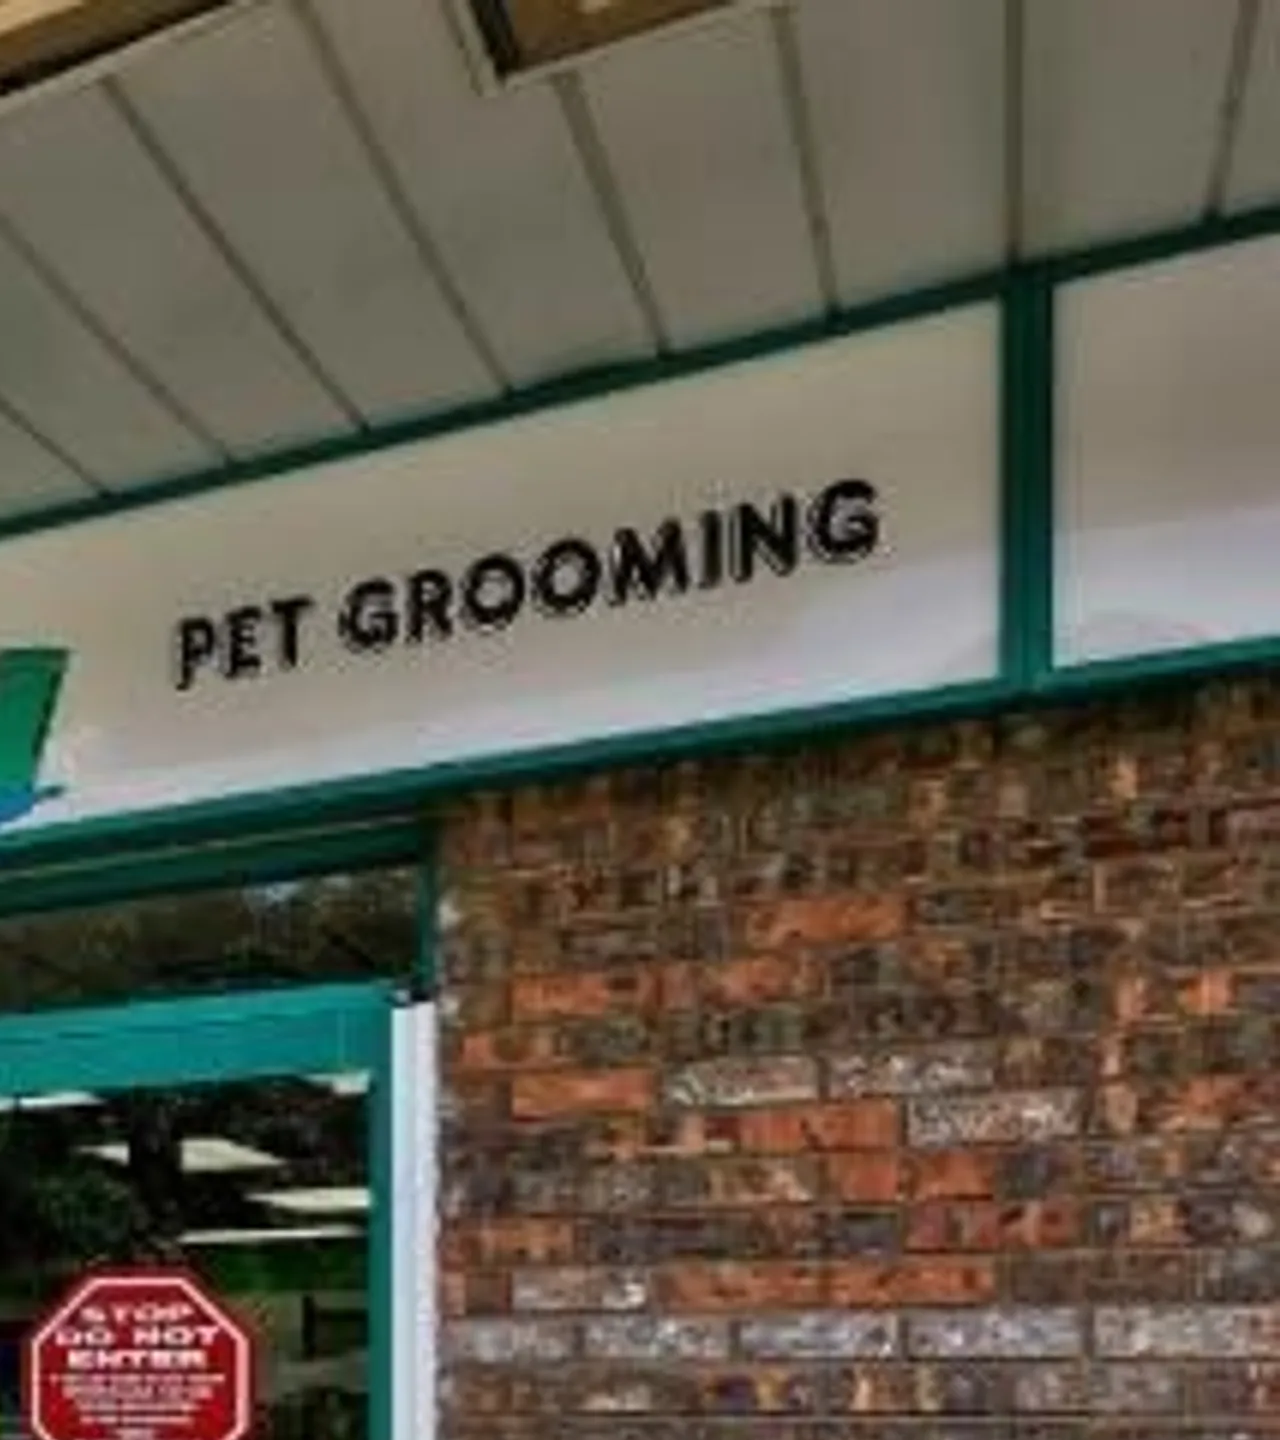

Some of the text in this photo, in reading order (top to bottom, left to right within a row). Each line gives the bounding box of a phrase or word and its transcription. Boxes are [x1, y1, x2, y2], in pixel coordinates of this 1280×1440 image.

[175, 478, 881, 690] PET GROOMING
[54, 1325, 219, 1346] DO NOT
[67, 1349, 208, 1369] ENTER
